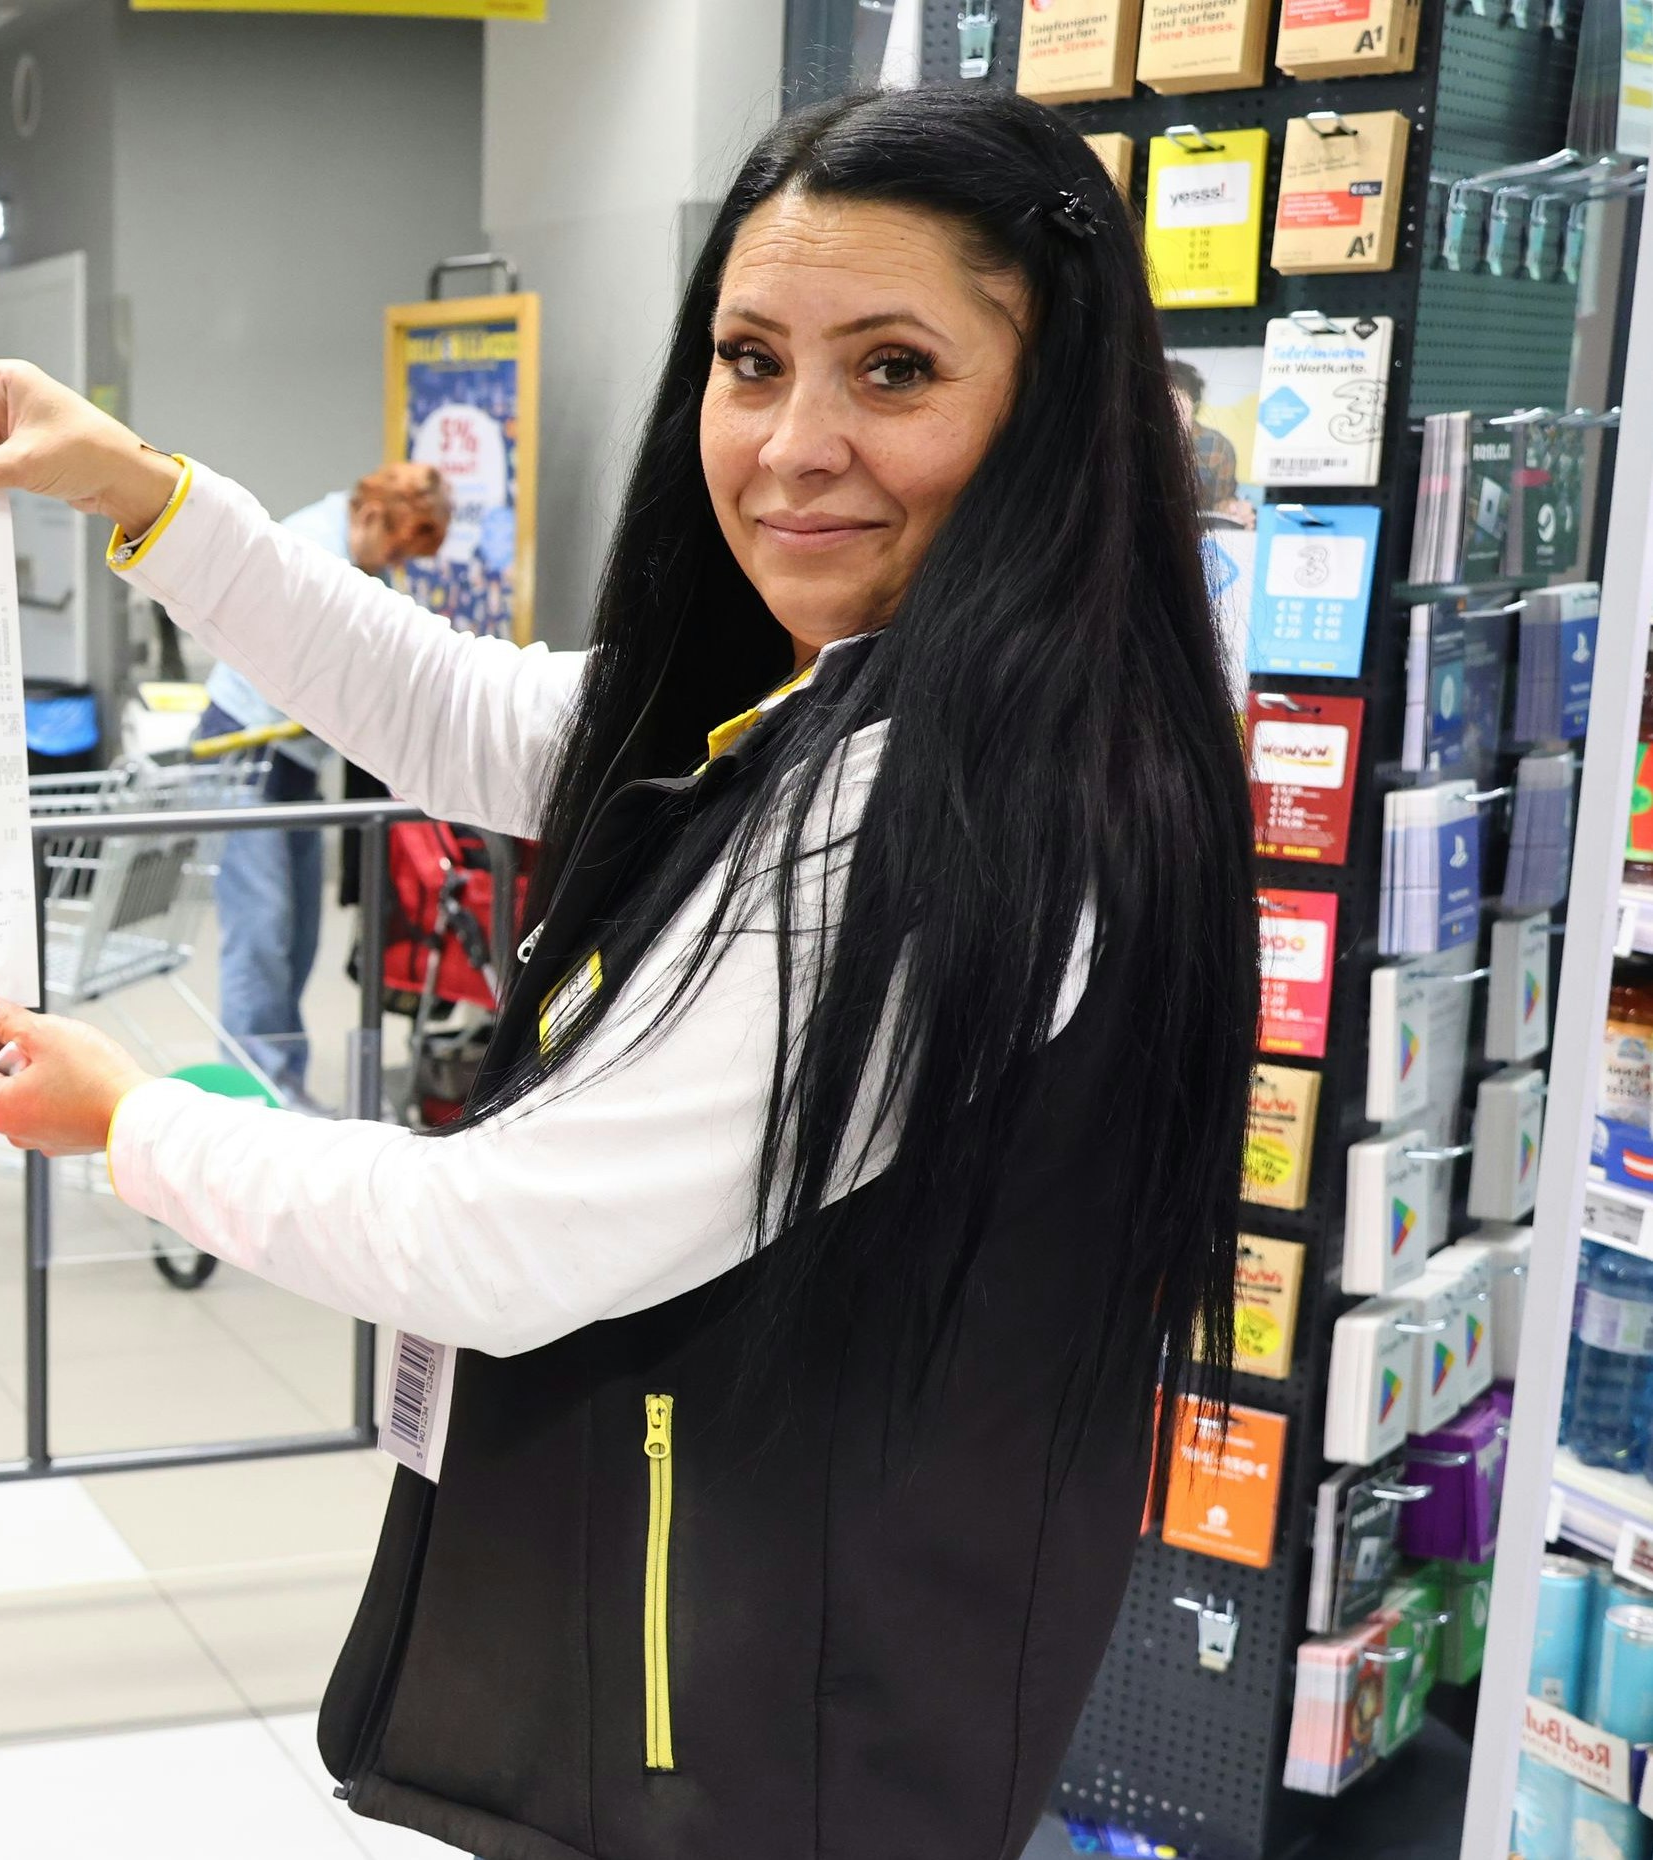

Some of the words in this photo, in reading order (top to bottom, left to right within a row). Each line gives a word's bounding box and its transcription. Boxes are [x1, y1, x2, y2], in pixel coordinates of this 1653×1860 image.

[1030, 14, 1108, 34] Telefonieren
[1150, 18, 1176, 31] und
[1181, 9, 1225, 27] surfen
[1029, 36, 1052, 47] und
[1057, 28, 1097, 42] surfen
[1150, 30, 1184, 43] ohne
[1187, 22, 1236, 37] Stress.
[1354, 25, 1383, 54] A1
[1029, 47, 1060, 60] ohne
[1064, 39, 1107, 53] Stress.
[1170, 182, 1225, 207] yesss!
[1348, 232, 1374, 258] A1
[1269, 364, 1290, 375] mit
[1296, 362, 1366, 374] Wertkarte.
[1294, 544, 1330, 589] 3
[425, 1356, 436, 1394] 123457
